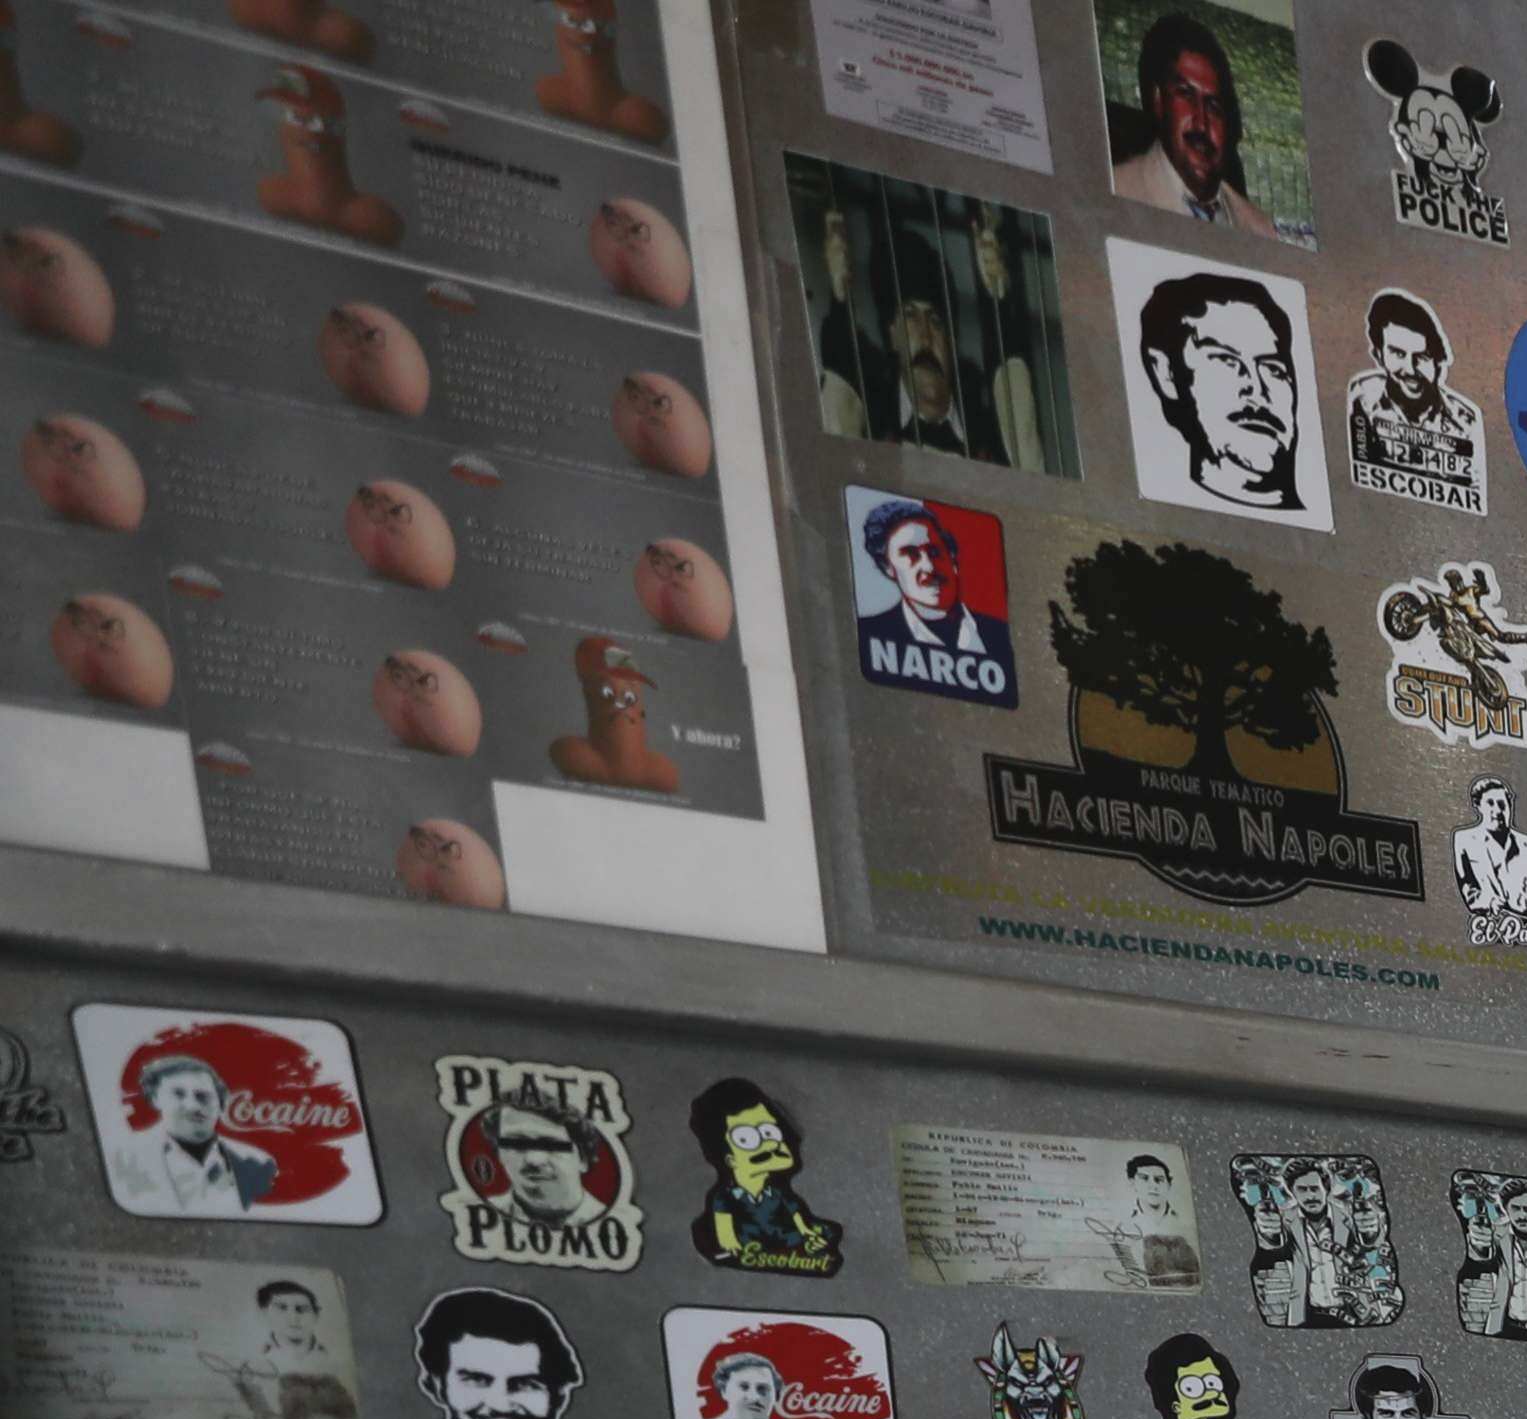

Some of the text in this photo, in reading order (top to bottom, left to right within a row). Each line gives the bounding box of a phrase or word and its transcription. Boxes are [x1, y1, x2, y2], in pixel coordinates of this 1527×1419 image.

[1398, 173, 1455, 204] FUCK
[1399, 193, 1509, 244] POLICE
[1353, 464, 1482, 512] ESCOBAR
[870, 636, 1006, 695] NARCO
[1395, 675, 1527, 739] STUNT
[1141, 768, 1202, 795] PARQUE
[1000, 769, 1217, 852] HACIENDA
[978, 915, 1441, 992] WWW.HACIENDANAPOLES.COM
[1469, 916, 1500, 946] El
[222, 1086, 353, 1136] Cocaine
[450, 1063, 617, 1124] PLATA
[466, 1203, 631, 1263] PLOMO
[741, 1238, 835, 1275] Escobart
